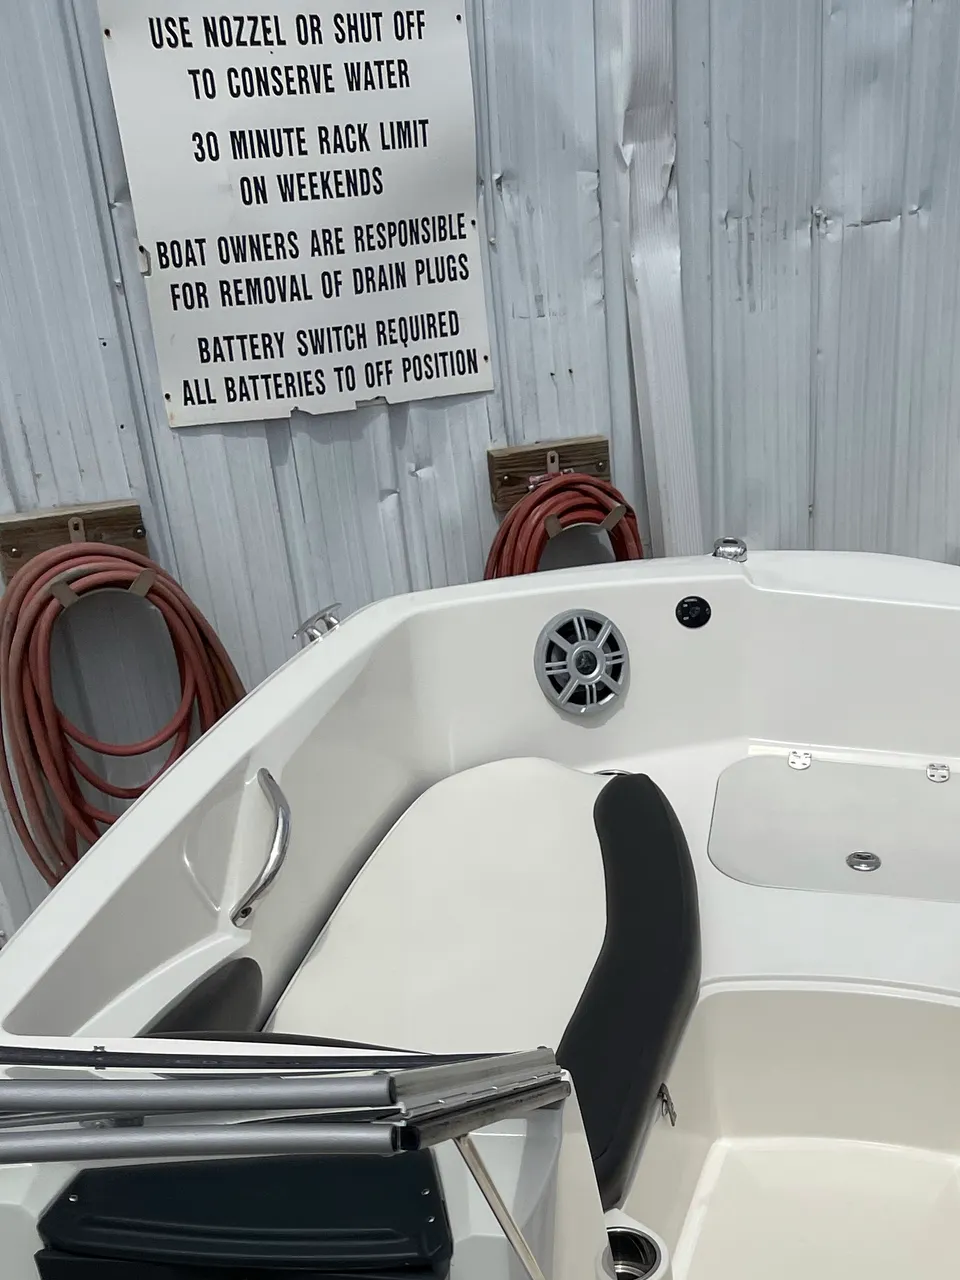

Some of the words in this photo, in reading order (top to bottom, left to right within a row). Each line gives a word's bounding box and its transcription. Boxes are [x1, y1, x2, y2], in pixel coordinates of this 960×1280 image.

[149, 17, 193, 48] USE
[203, 15, 286, 47] NOZZEL
[296, 14, 323, 45] OR
[334, 12, 382, 43] SHUT
[394, 10, 425, 40] OFF
[188, 69, 216, 99] TO
[227, 64, 334, 98] CONSERVE
[344, 59, 410, 91] WATER
[192, 132, 219, 162] 30
[230, 127, 308, 159] MINUTE
[318, 123, 370, 154] RACK
[380, 119, 428, 150] LIMIT
[240, 176, 268, 205] ON
[277, 167, 383, 202] WEEKENDS
[156, 238, 206, 269] BOAT
[218, 231, 299, 264] OWNERS
[311, 228, 345, 257] ARE
[354, 213, 466, 252] RESPONSIBLE
[170, 282, 209, 310] FOR
[219, 274, 313, 306] REMOVAL
[321, 270, 342, 298] OF
[353, 262, 406, 294] DRAIN
[415, 254, 469, 285] PLUGS
[198, 332, 284, 363] BATTERY
[297, 323, 367, 356] SWITCH
[376, 311, 459, 348] REQUIRED
[183, 379, 216, 406] ALL
[224, 369, 325, 402] BATTERIES
[334, 365, 355, 392] TO
[365, 360, 392, 388] OFF
[402, 348, 478, 382] POSITION
